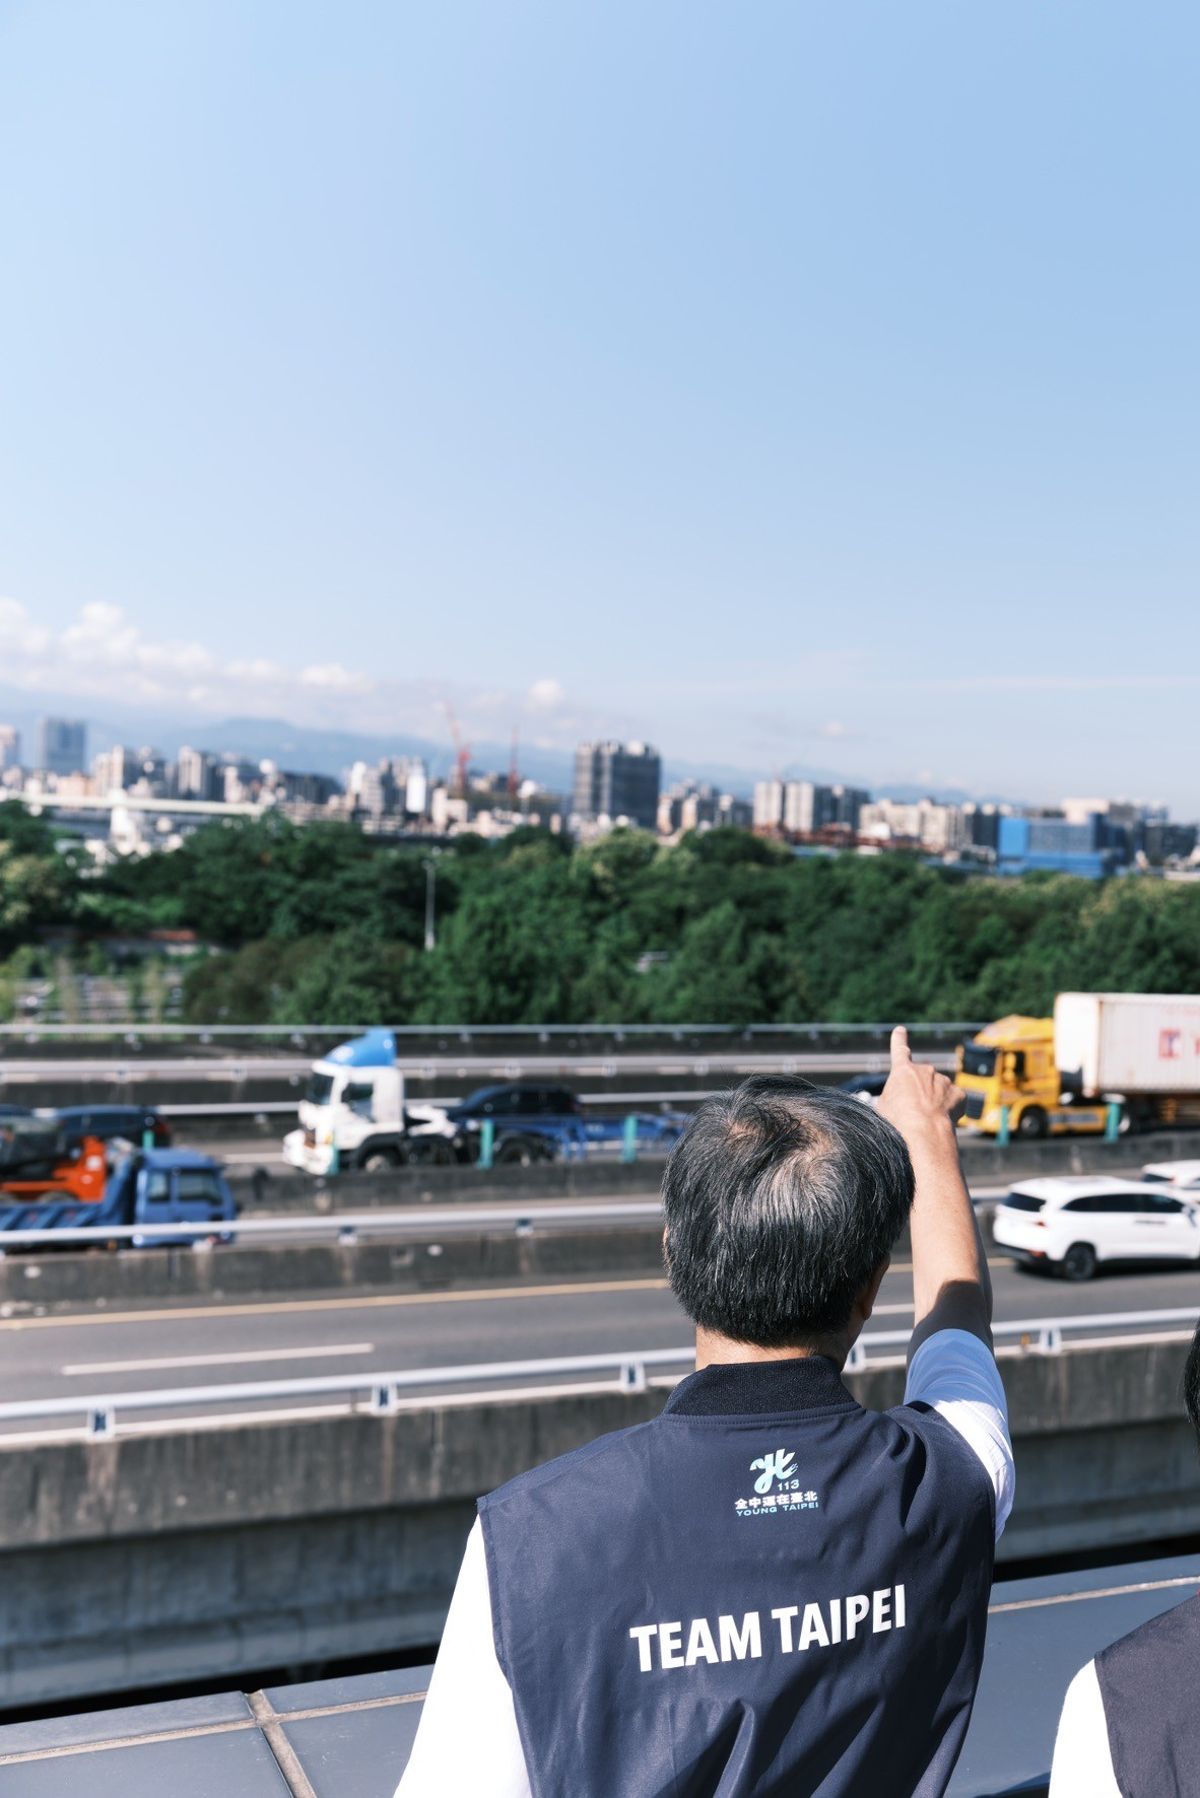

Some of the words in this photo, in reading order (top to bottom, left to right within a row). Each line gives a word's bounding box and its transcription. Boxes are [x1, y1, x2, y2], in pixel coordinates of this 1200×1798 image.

[778, 1479, 799, 1491] 113
[736, 1507, 777, 1516] YOUNG
[782, 1502, 818, 1511] TAIPEI
[629, 1611, 762, 1672] TEAM
[771, 1584, 906, 1654] TAIPEI
